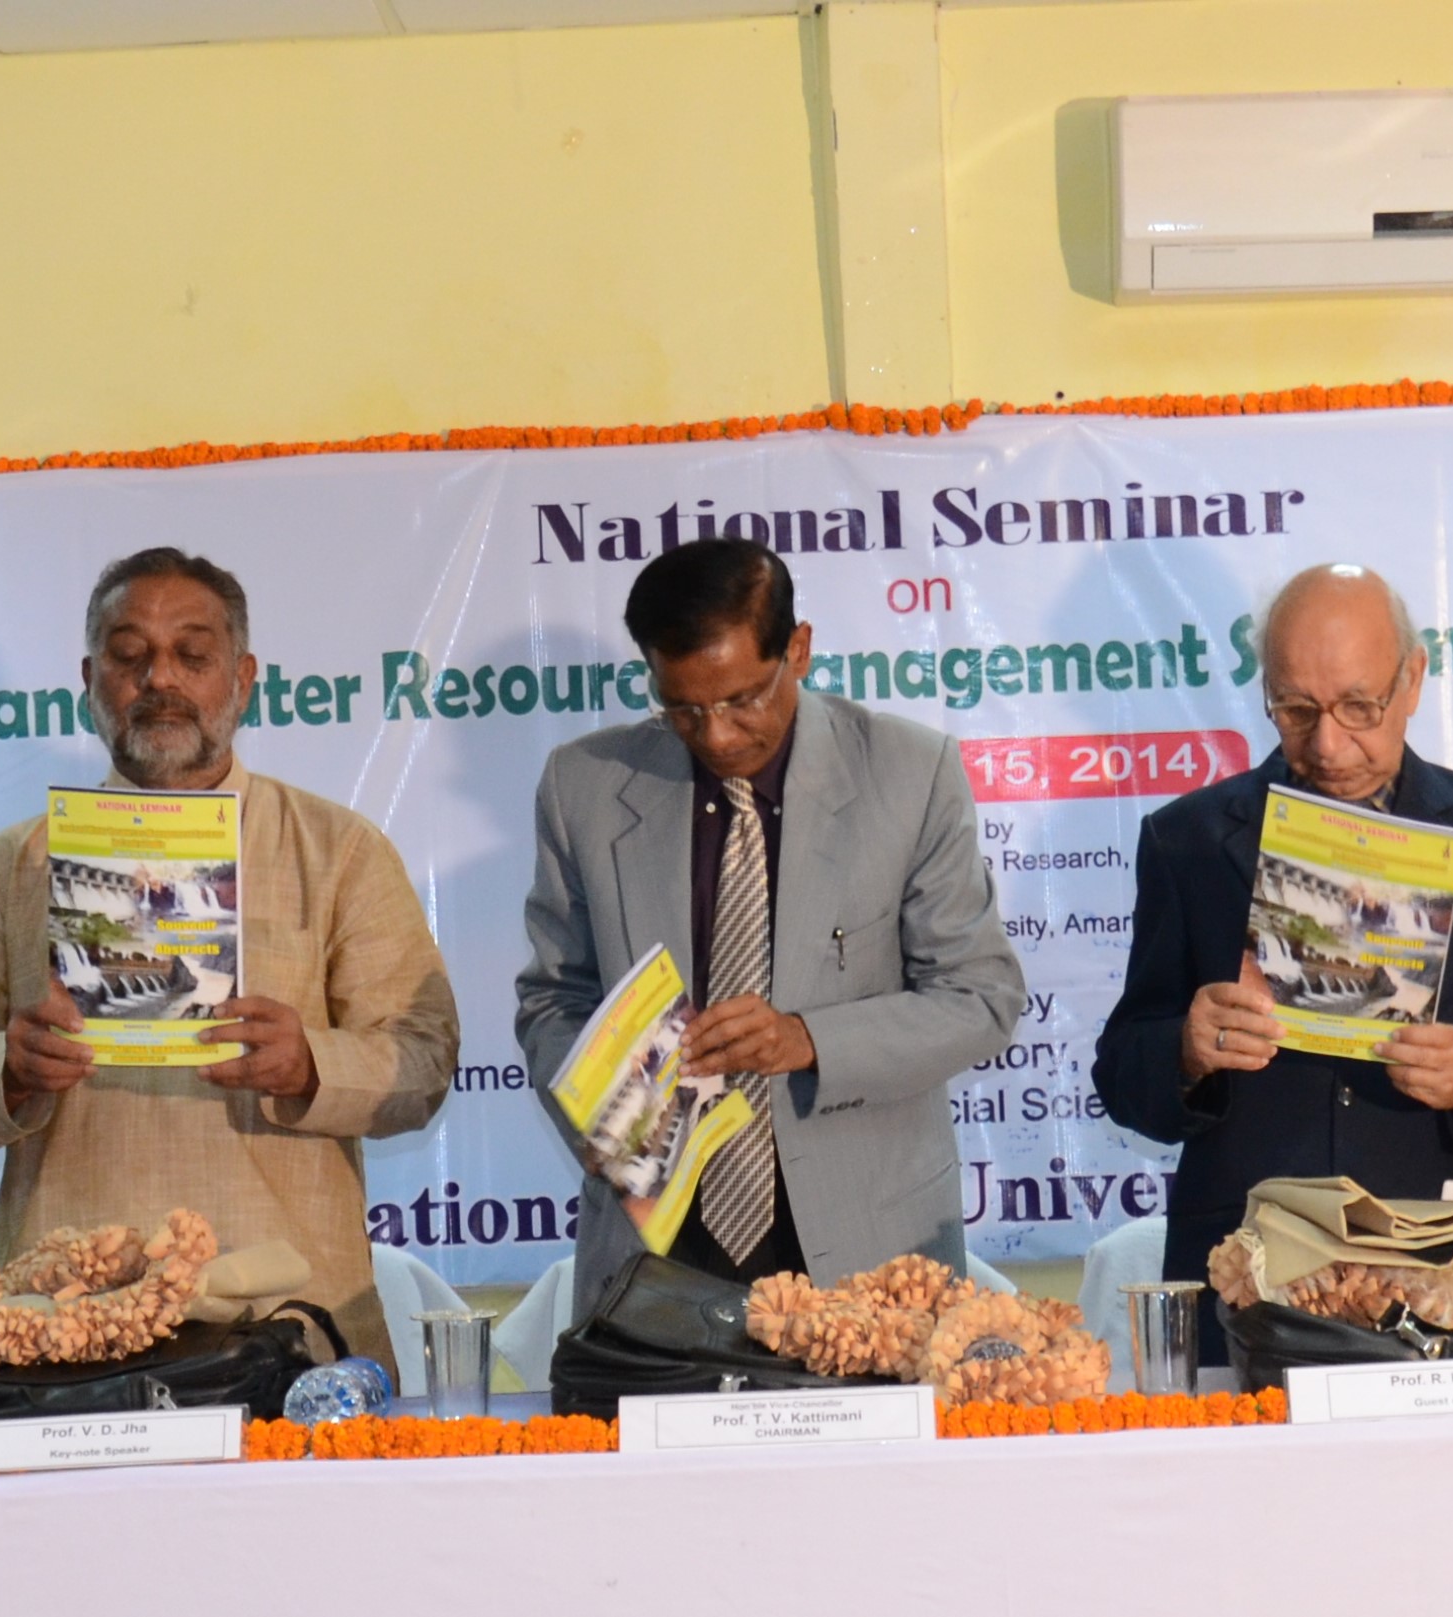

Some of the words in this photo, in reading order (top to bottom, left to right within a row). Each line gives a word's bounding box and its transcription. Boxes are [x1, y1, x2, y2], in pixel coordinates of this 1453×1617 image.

[932, 482, 1305, 548] Seminar
[887, 577, 952, 613] on
[801, 623, 1209, 709] anagement
[1069, 742, 1218, 787] 2014)
[985, 819, 1014, 844] by
[1003, 846, 1129, 872] Research,
[1390, 1375, 1426, 1387] Prof.
[1431, 1373, 1446, 1385] R.
[1414, 1397, 1449, 1407] Guest
[712, 1415, 747, 1427] Prof.
[753, 1414, 767, 1425] T.
[772, 1413, 786, 1424] V.
[791, 1410, 862, 1423] Kattimani
[42, 1426, 77, 1439] Prof.
[81, 1425, 96, 1437] V.
[100, 1425, 116, 1436] D.
[120, 1423, 147, 1435] Jha
[755, 1427, 820, 1438] CHAIRMAN
[49, 1447, 100, 1460] Key-note
[104, 1445, 150, 1458] Speaker
